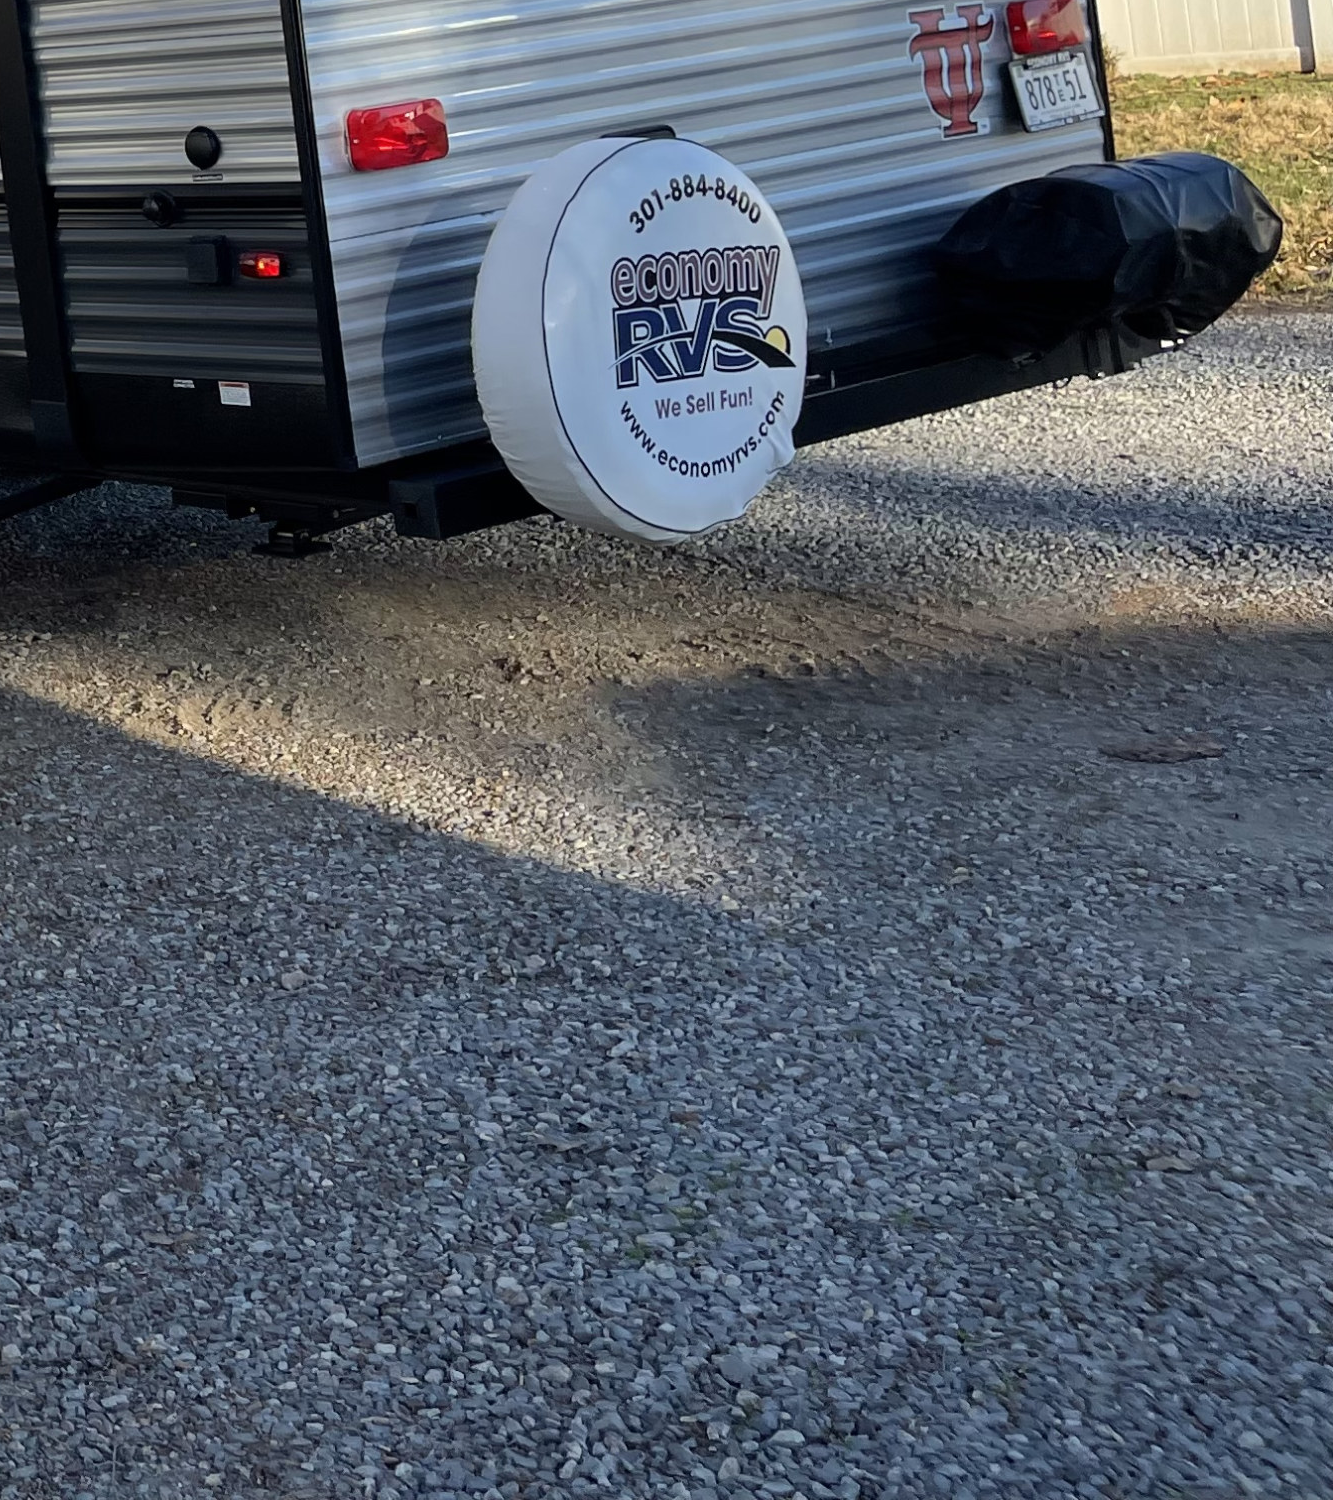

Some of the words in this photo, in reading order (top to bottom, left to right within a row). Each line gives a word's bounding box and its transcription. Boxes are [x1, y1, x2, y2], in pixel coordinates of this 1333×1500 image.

[629, 173, 761, 234] 301-884-8400
[611, 244, 781, 319] economy
[611, 296, 767, 389] RVS
[620, 390, 785, 478] www.economyrvs.com
[654, 397, 683, 419] We
[686, 391, 716, 414] Sell
[719, 386, 754, 409] Fun!
